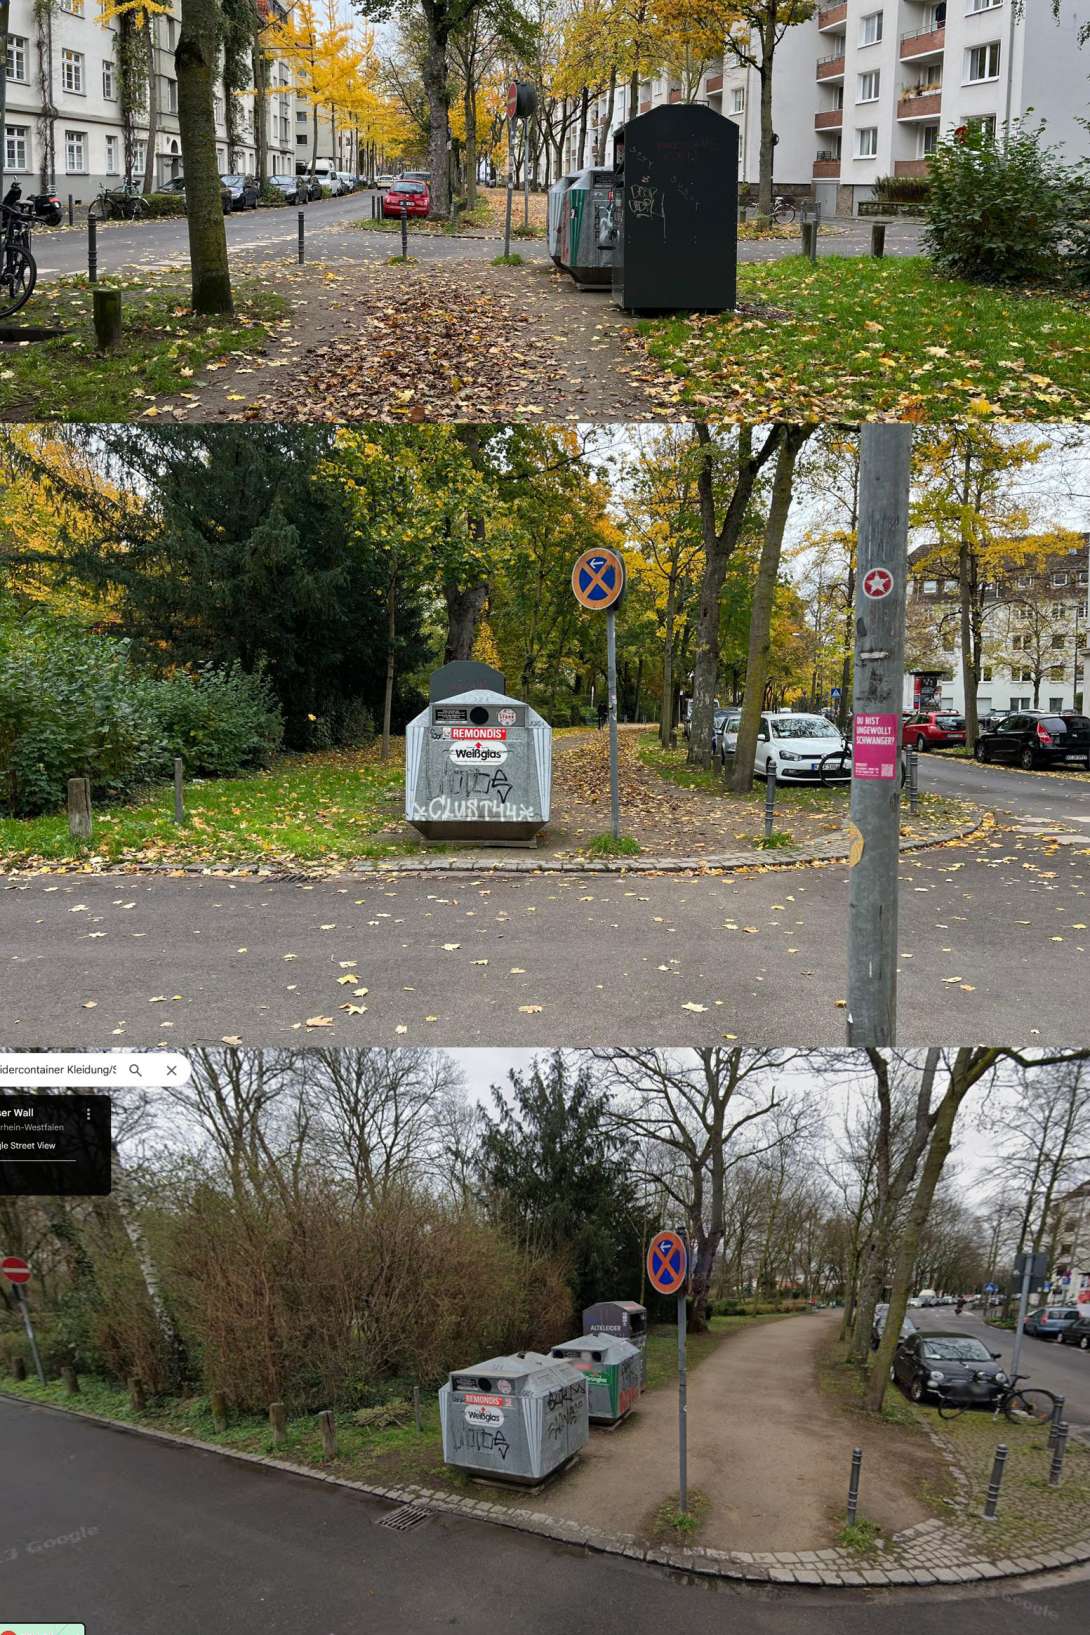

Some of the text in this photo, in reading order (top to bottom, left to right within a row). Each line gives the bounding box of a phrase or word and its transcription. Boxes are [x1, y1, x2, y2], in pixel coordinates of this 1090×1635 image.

[856, 726, 892, 735] UNGEWOLLT
[856, 736, 896, 745] SCHWANGER?
[456, 748, 502, 761] Weißglas
